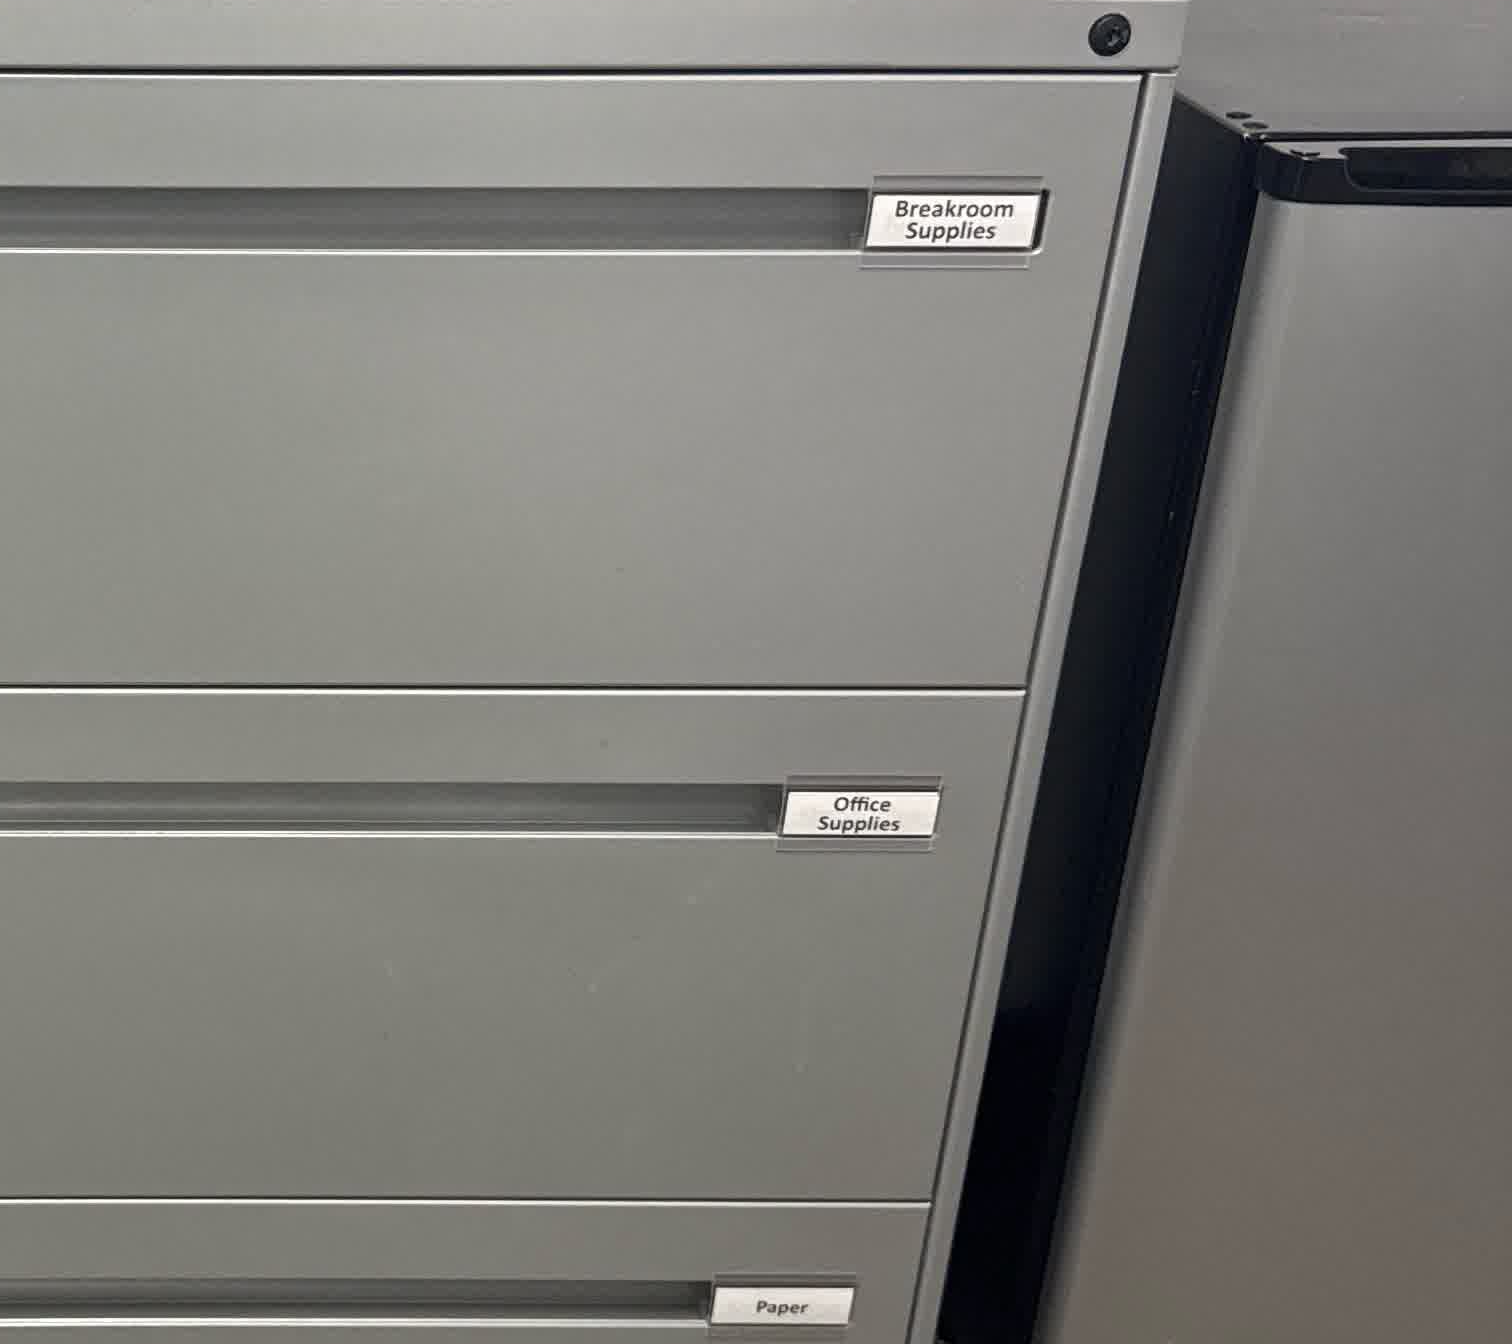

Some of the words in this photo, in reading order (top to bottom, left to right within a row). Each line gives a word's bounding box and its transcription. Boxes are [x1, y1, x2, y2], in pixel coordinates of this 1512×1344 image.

[895, 200, 1014, 218] Breakroom
[905, 221, 997, 243] Supplies
[833, 796, 892, 812] Office
[817, 816, 901, 834] Supplies
[756, 1300, 809, 1316] Paper
